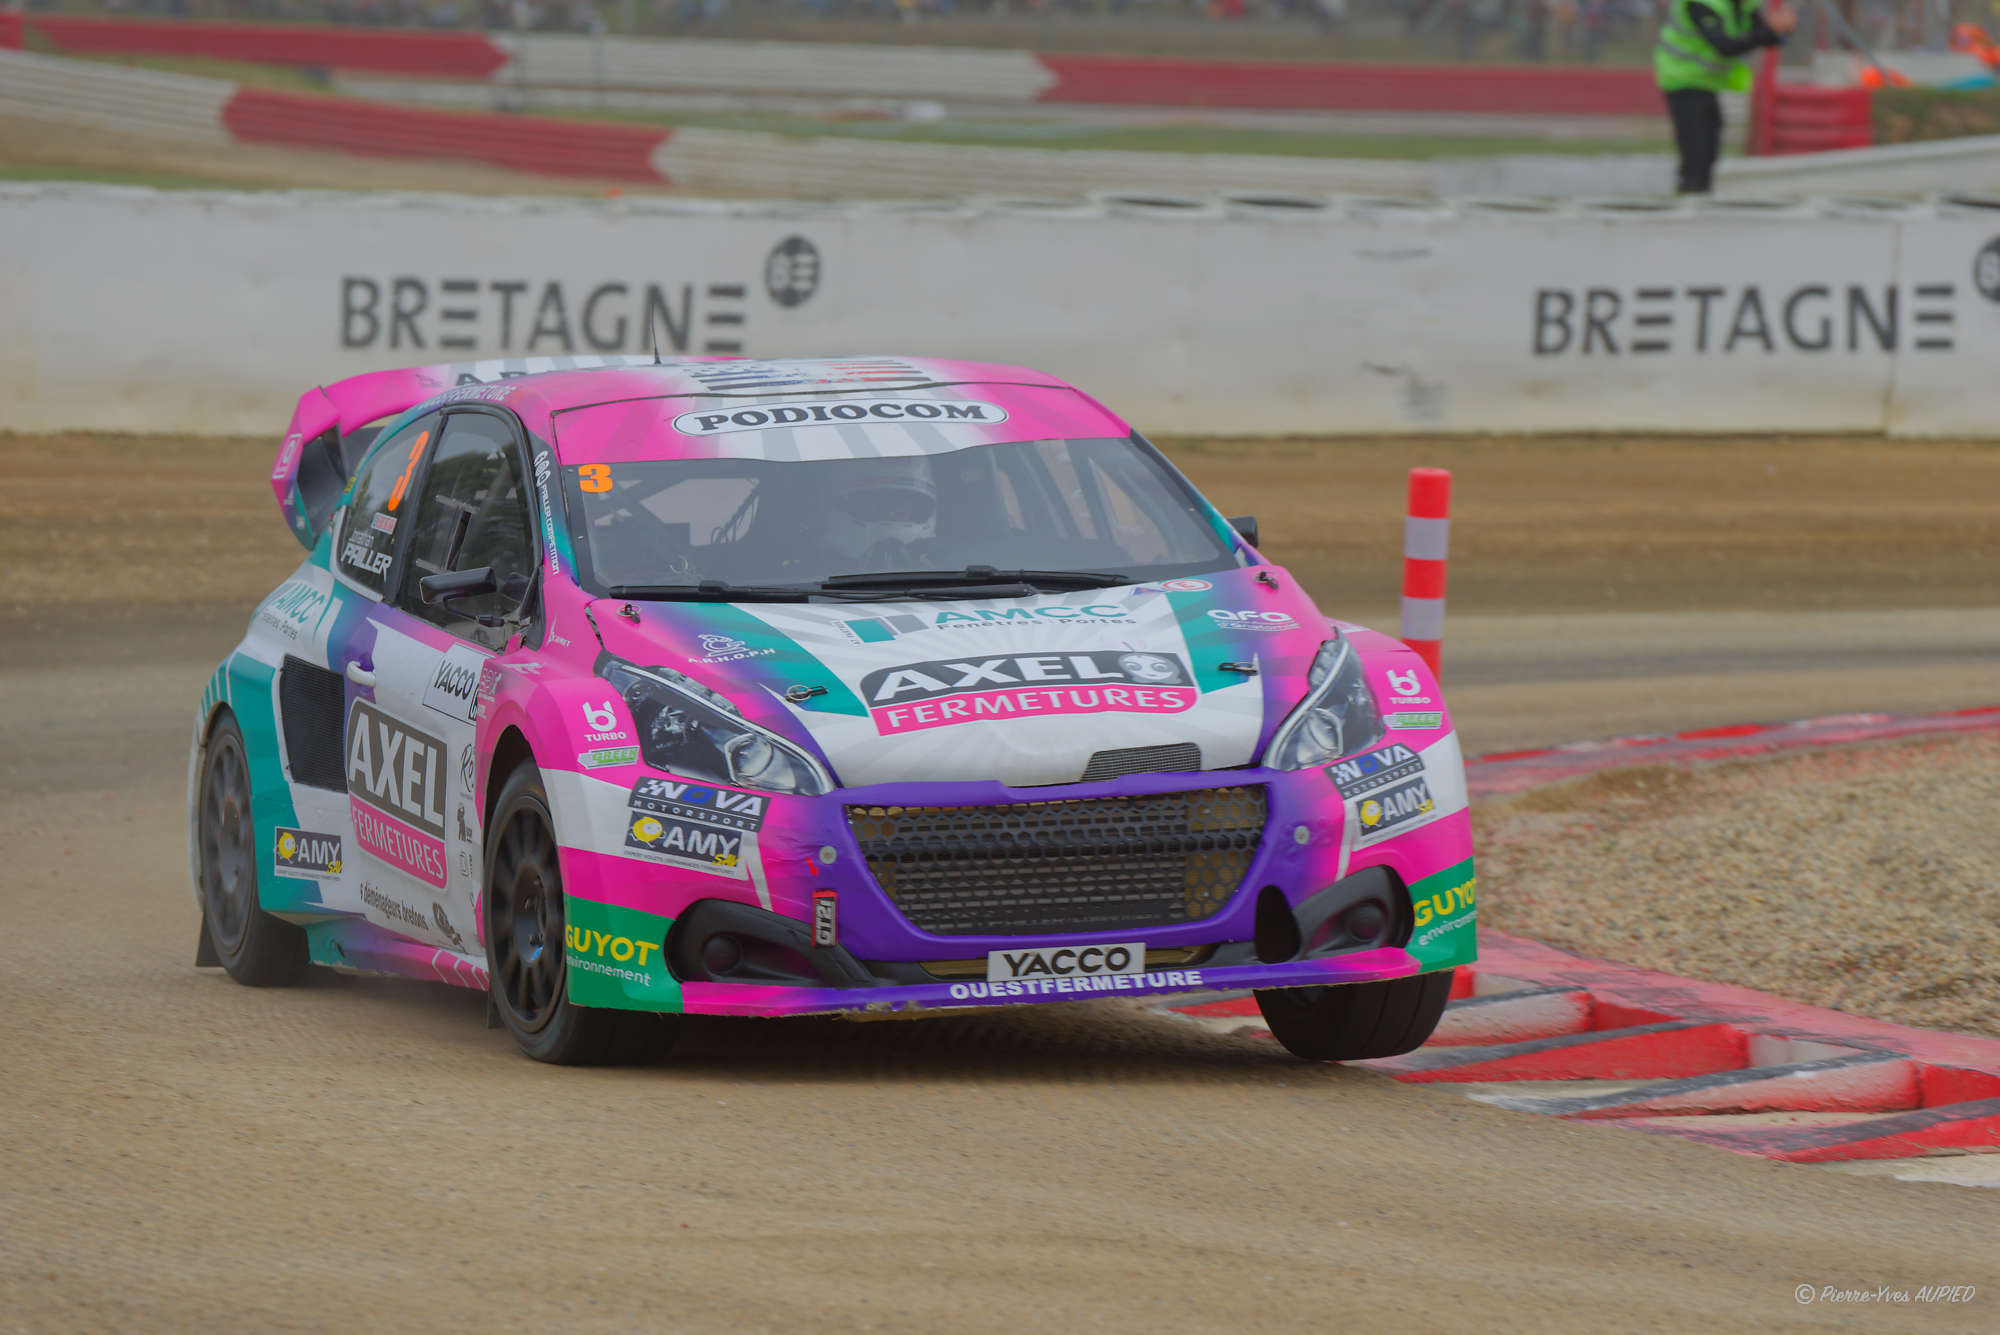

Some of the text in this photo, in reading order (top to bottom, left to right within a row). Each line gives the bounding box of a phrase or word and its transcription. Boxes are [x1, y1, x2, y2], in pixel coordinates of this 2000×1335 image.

[341, 276, 746, 352] BRETAGNE
[1532, 284, 1956, 355] BRETAGNE
[694, 403, 989, 431] PODIOCOM
[388, 430, 429, 511] 3
[578, 464, 613, 492] 3
[935, 605, 1129, 624] AMCC
[1060, 617, 1137, 626] Portes
[433, 659, 475, 700] YACCO
[874, 655, 1124, 701] AXEL
[886, 688, 1185, 727] FERMETURES
[584, 731, 627, 741] TURBO
[350, 713, 444, 828] AXEL
[1338, 745, 1416, 779] NOVA
[633, 799, 757, 829] MOTORSPORT
[655, 780, 763, 816] NOVA
[1383, 783, 1427, 820] AMY
[297, 838, 340, 865] AMY
[352, 805, 444, 880] FERMETURES
[663, 826, 740, 858] AMY
[566, 924, 660, 966] GUYOT
[1002, 947, 1132, 977] YACCO
[950, 970, 1204, 1000] OUESTFERMETURE
